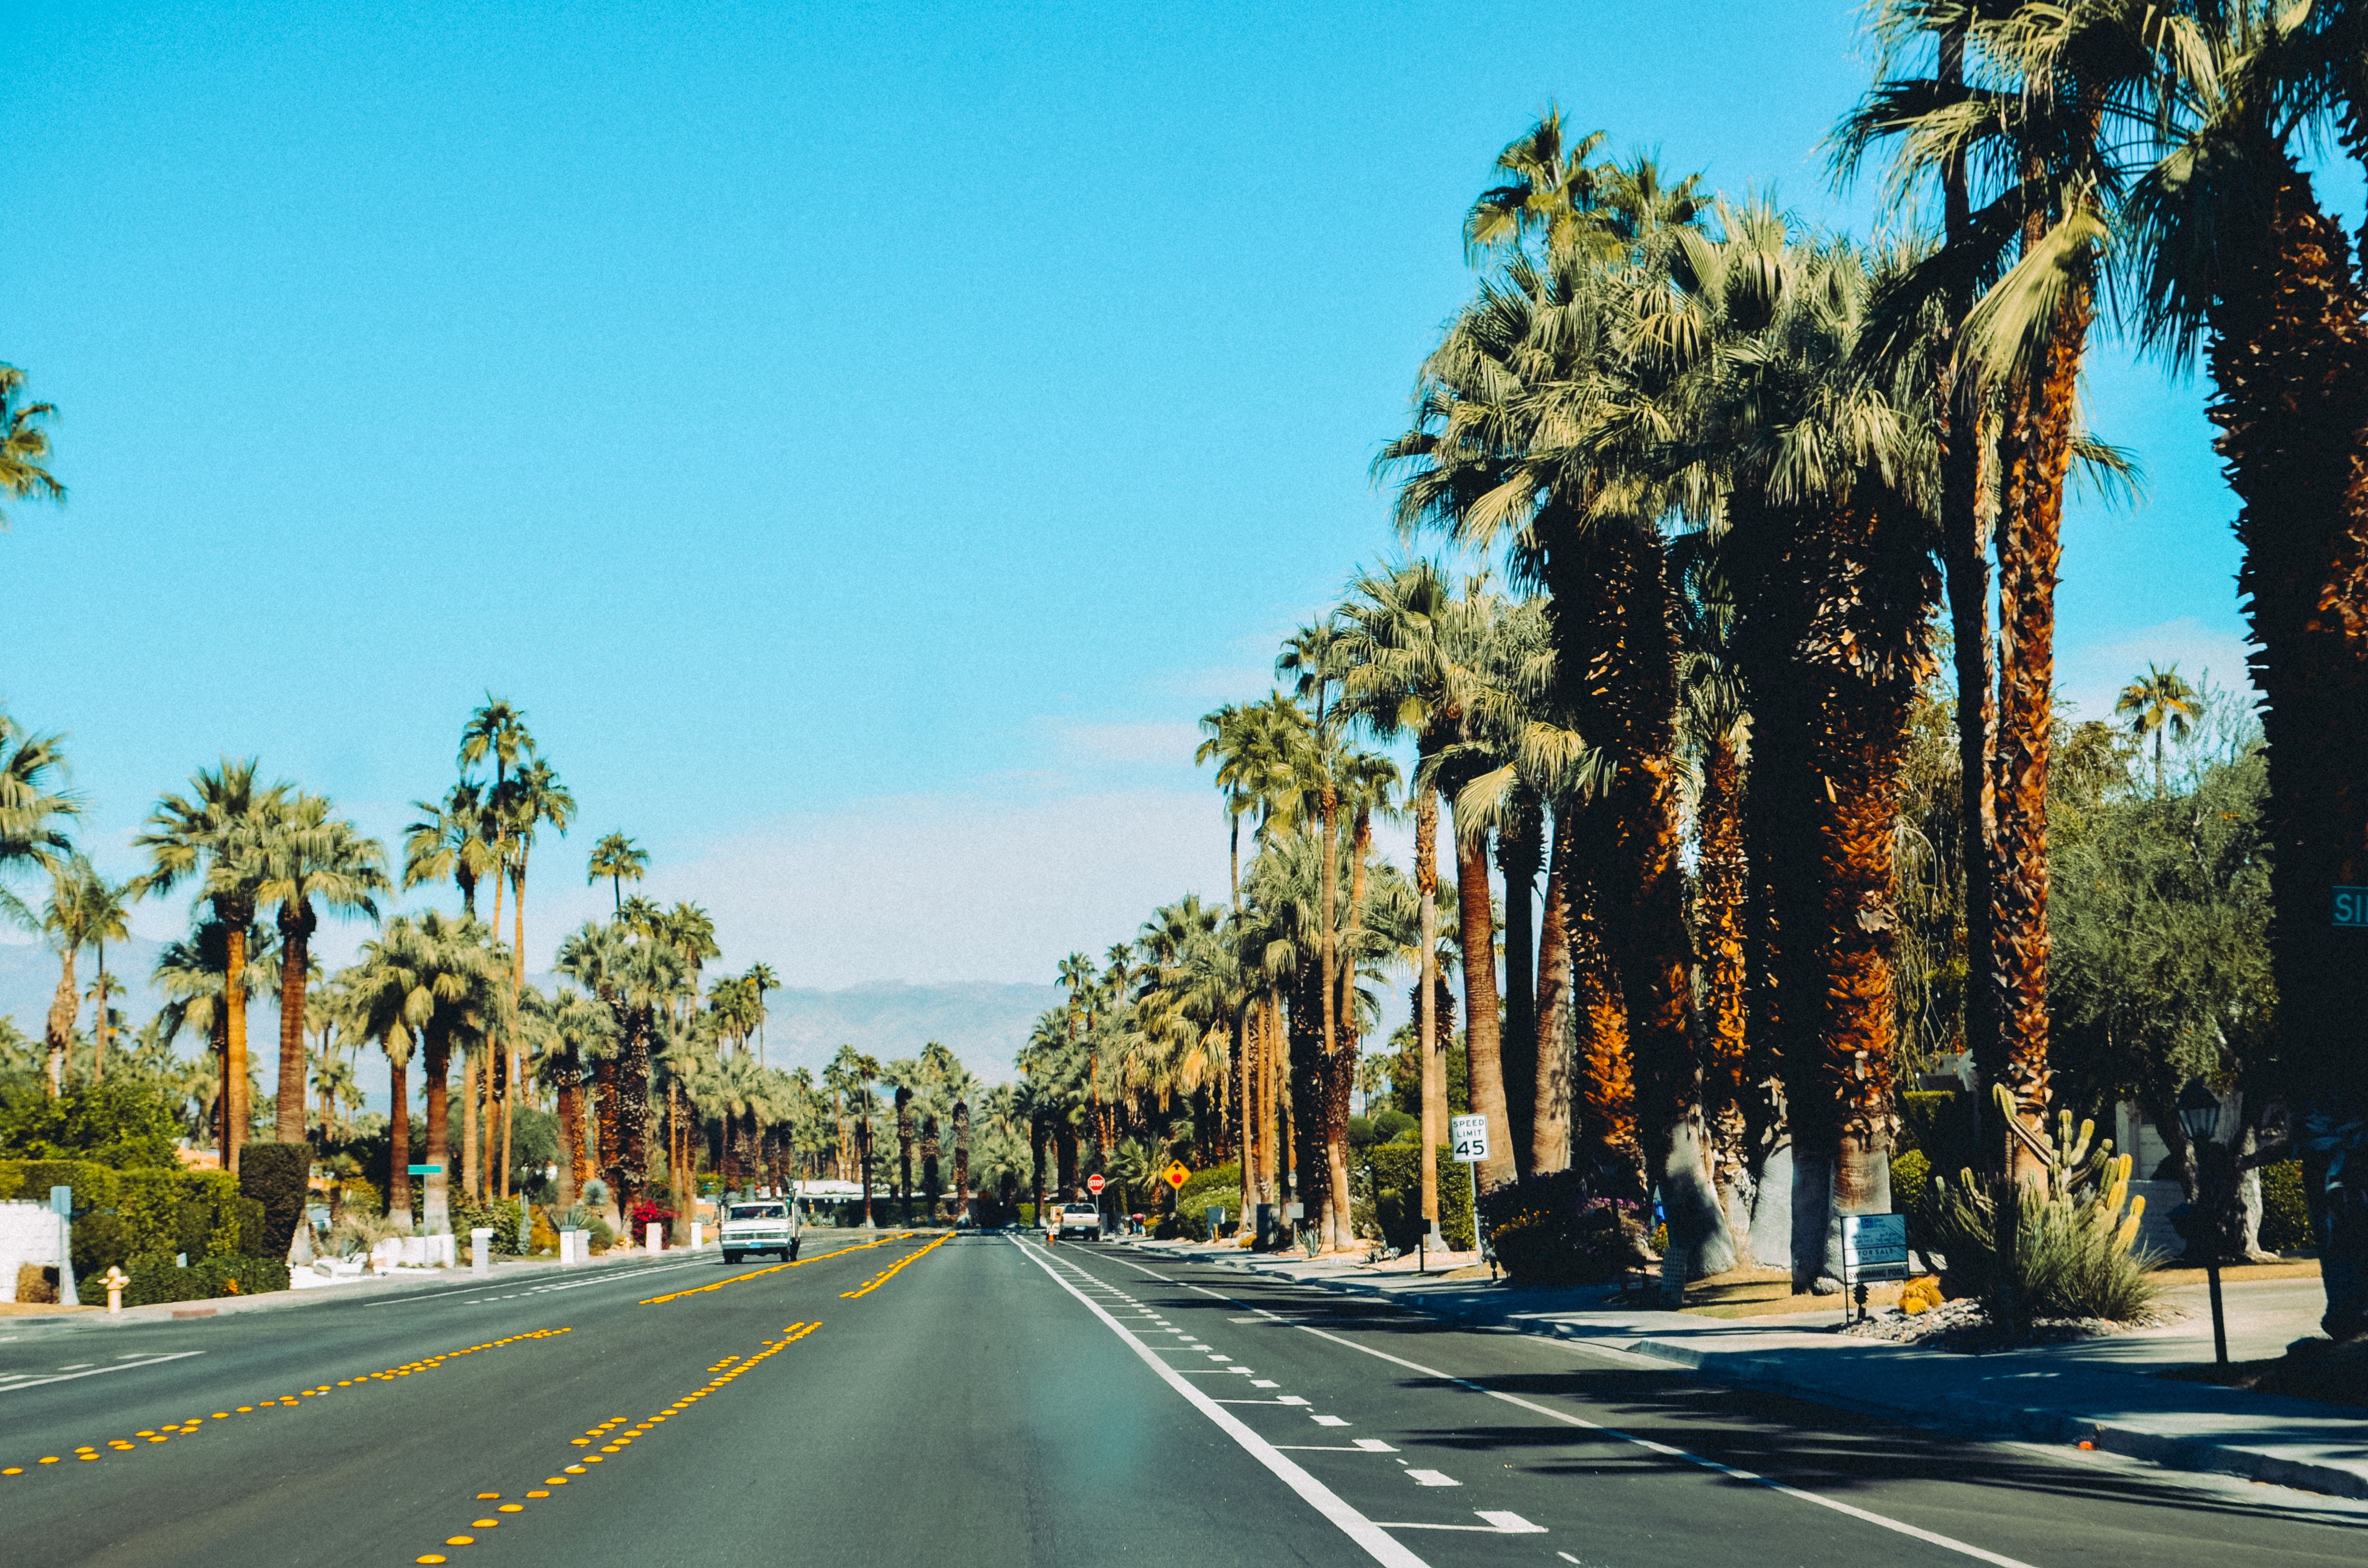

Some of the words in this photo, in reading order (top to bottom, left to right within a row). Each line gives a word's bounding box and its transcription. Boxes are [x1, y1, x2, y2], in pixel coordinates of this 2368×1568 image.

[2334, 894, 2368, 922] SI
[1453, 1119, 1484, 1128] SPEED
[1456, 1129, 1482, 1138] LIMIT
[1455, 1139, 1484, 1156] 45
[1848, 1269, 1886, 1279] SWIMMING
[1888, 1268, 1905, 1276] POOL
